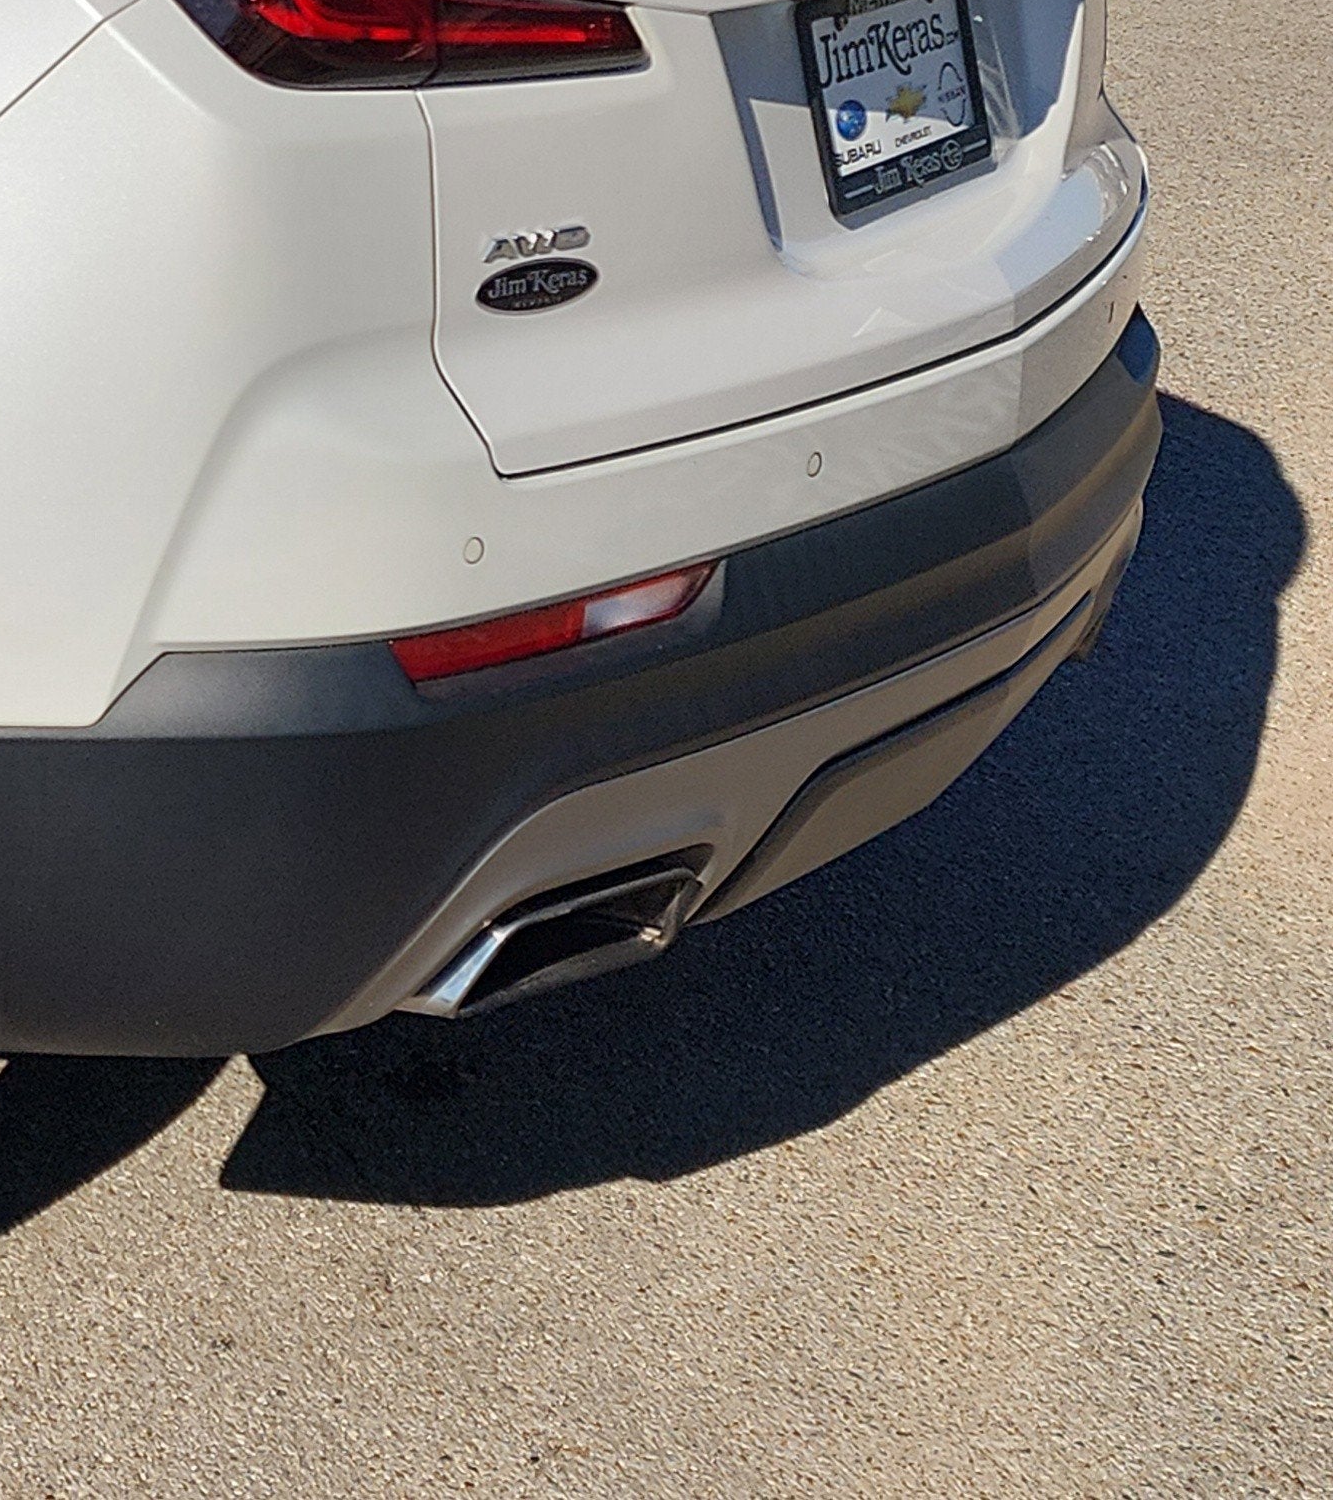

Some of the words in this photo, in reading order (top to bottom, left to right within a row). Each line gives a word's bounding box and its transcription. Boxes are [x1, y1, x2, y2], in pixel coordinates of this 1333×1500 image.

[834, 140, 882, 167] SUBARU
[483, 226, 591, 264] AWD
[488, 276, 528, 299] Jim
[528, 268, 588, 294] Keras
